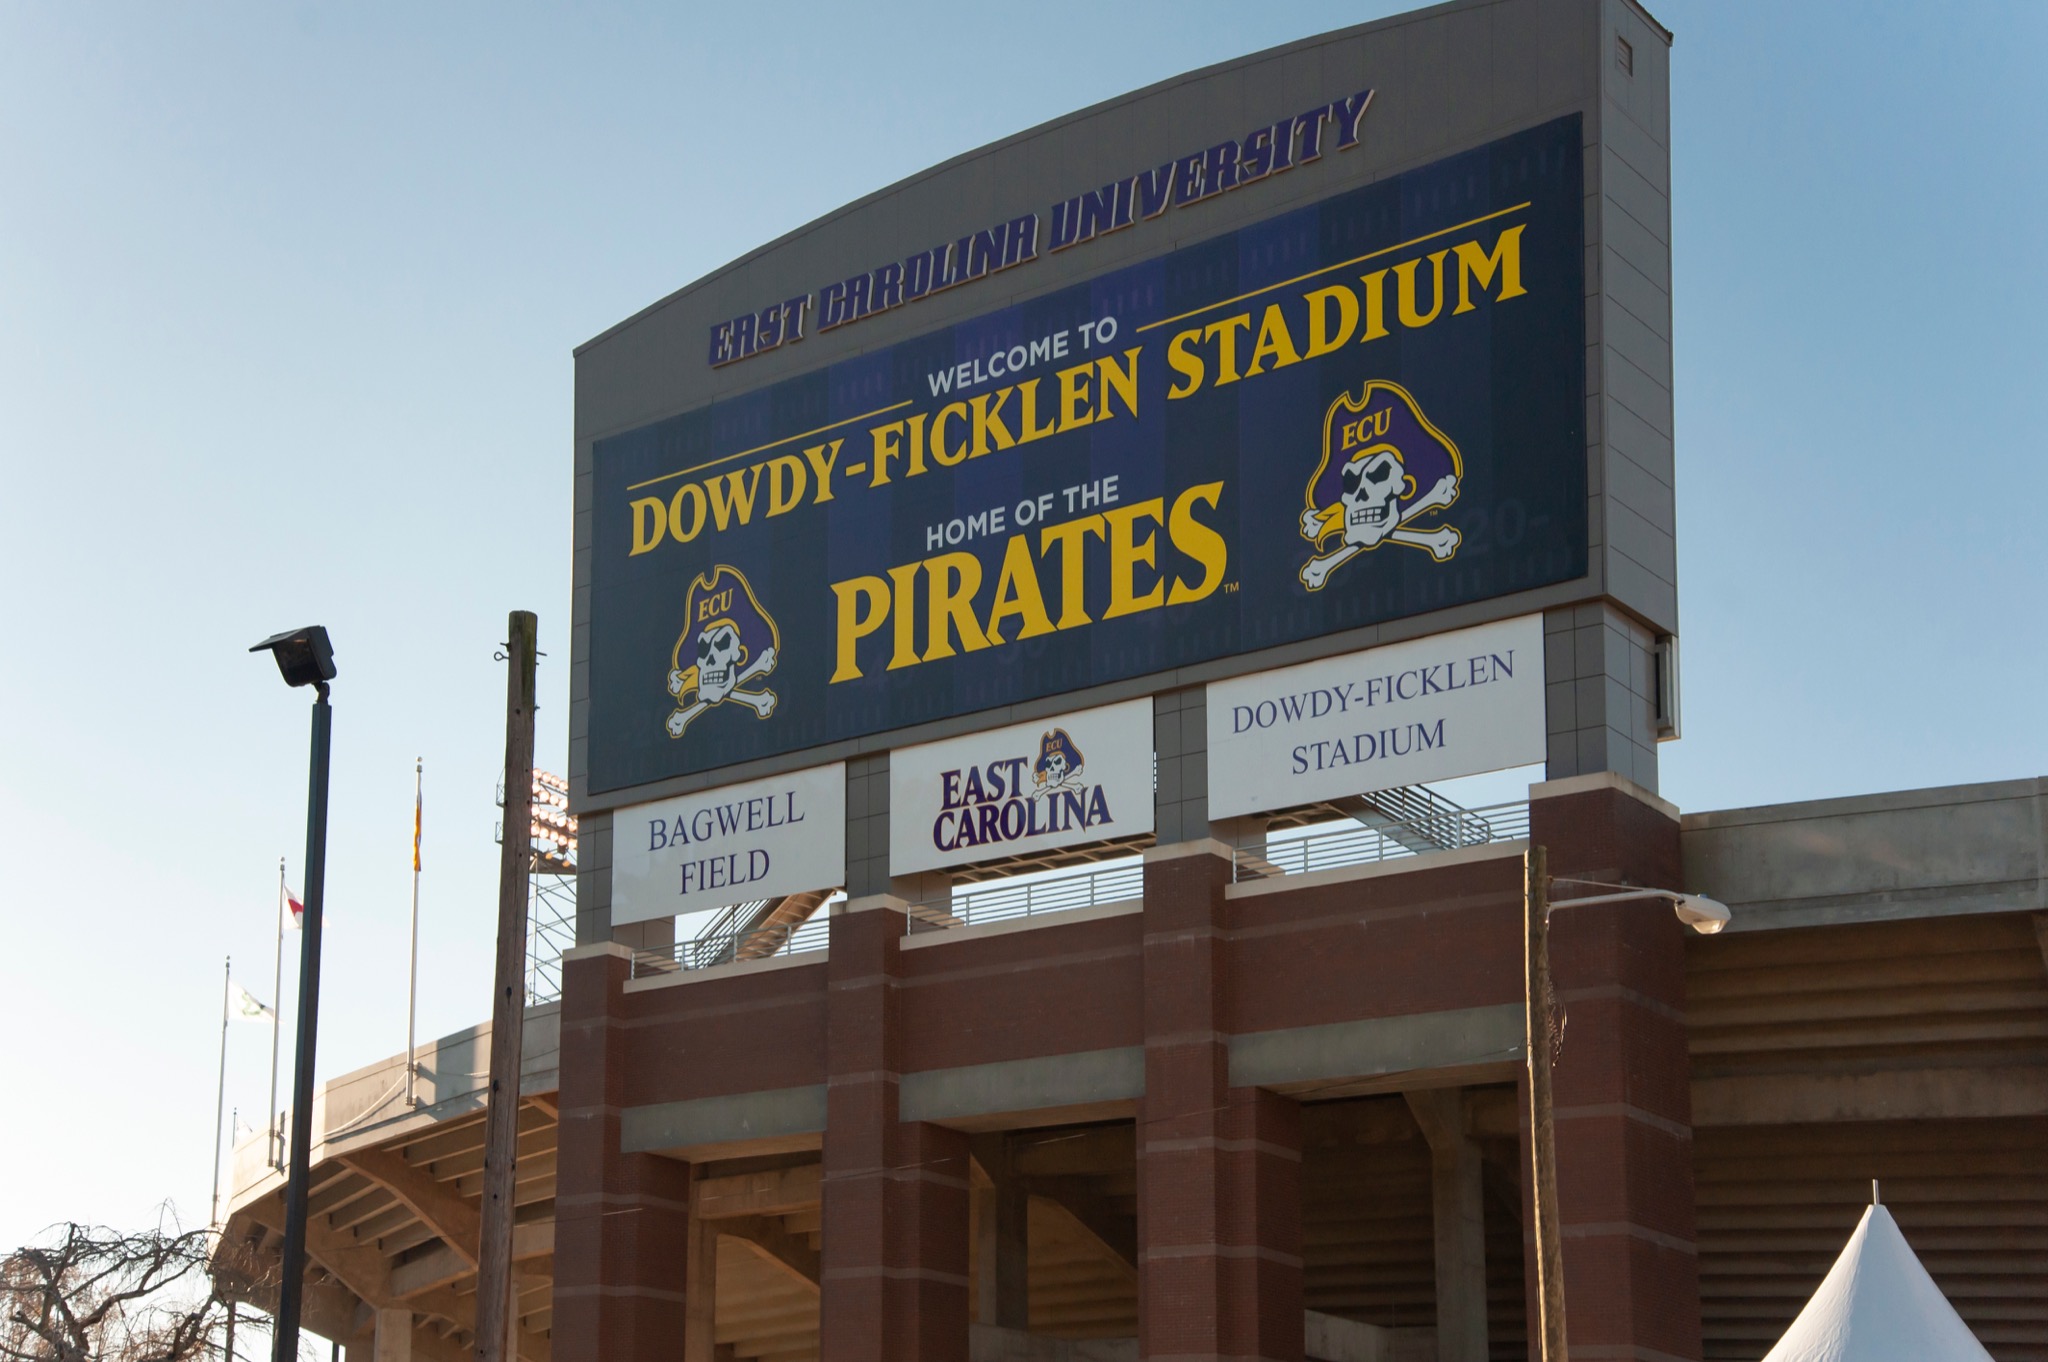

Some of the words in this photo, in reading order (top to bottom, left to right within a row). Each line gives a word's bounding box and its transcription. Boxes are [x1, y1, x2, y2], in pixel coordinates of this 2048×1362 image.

[708, 294, 813, 368] EAST
[817, 212, 1040, 333] CAROLINA
[1048, 88, 1377, 253] UNIVERSITY
[927, 330, 1069, 397] WELCOME
[1078, 316, 1118, 349] TO
[629, 345, 1143, 557] DOWDY-FICKLEN
[1166, 223, 1528, 400] STADIUM
[1341, 406, 1392, 451] ECU
[926, 506, 1006, 551] HOME
[1014, 493, 1054, 526] OF
[1062, 475, 1119, 513] THE
[698, 588, 734, 622] ECU
[829, 480, 1225, 685] PIRATES
[1232, 649, 1516, 735] DOWDY-FICKLEN
[1045, 738, 1063, 753] ECU
[1292, 718, 1447, 776] STADIUM
[939, 756, 1029, 811] EAST
[647, 790, 806, 852] BAGWELL
[932, 783, 1115, 853] CAROLINA
[679, 848, 770, 895] FIELD
